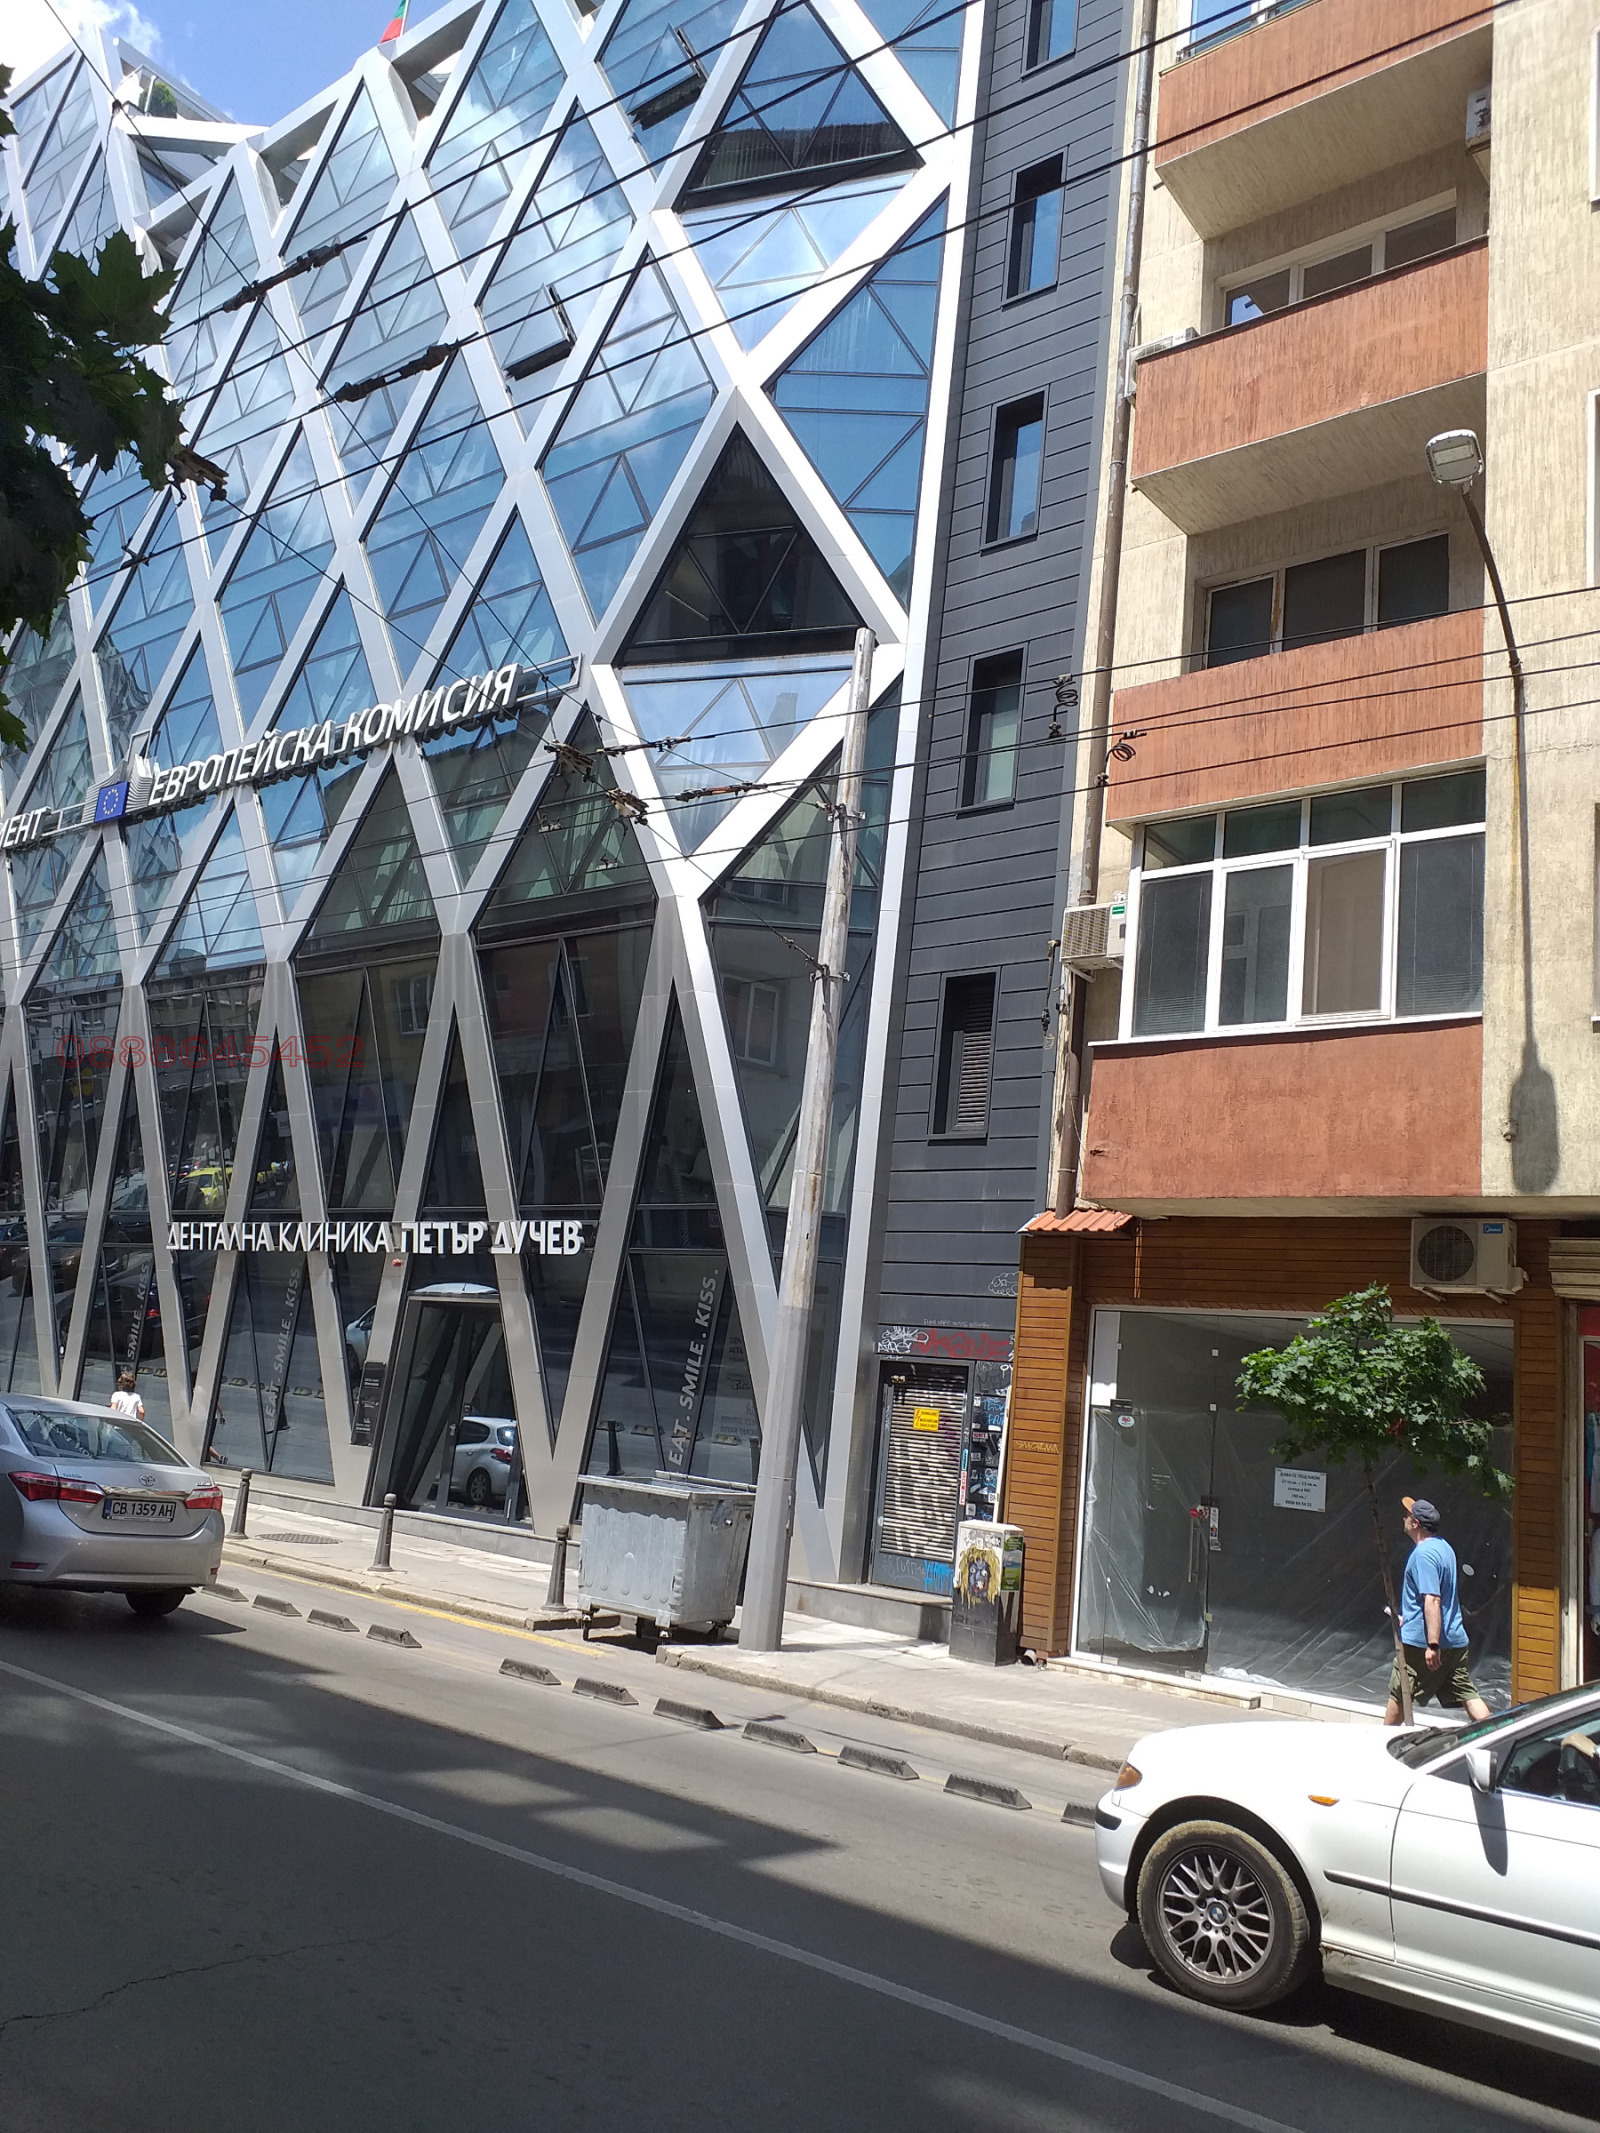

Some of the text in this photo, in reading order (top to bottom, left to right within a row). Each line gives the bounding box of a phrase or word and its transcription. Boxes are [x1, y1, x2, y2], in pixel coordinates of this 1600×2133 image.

[149, 663, 521, 806] ЕВРОПЕЙСКА КОМИСИЯ
[166, 1220, 583, 1255] ДЕНТАЛНА КЛИНИКА ПЕТЪР ДУЧЕВ
[112, 1501, 173, 1518] CB 1359 AH
